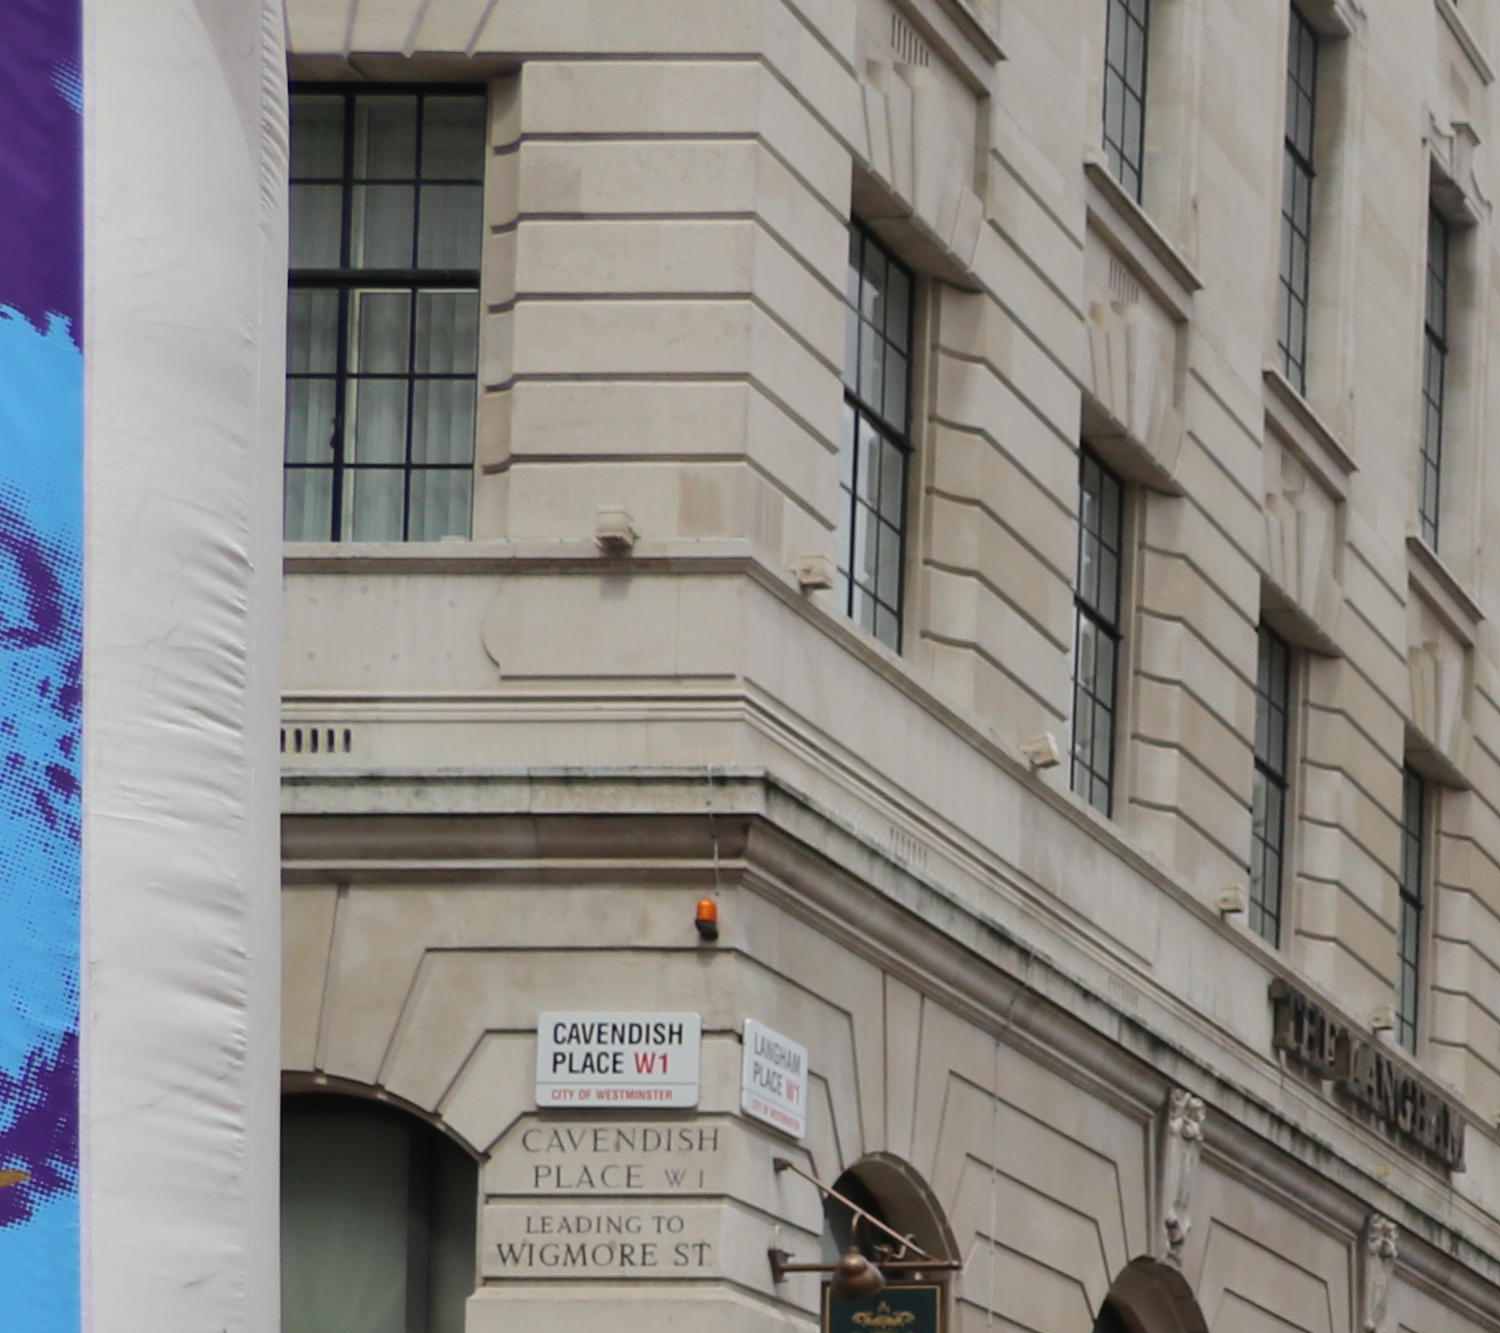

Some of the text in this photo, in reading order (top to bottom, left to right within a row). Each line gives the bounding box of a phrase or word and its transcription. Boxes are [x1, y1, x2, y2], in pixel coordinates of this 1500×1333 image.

[553, 1022, 684, 1045] CAVENDISH
[552, 1052, 669, 1074] PLACE W1
[754, 1032, 801, 1076] LANGHAM
[551, 1089, 673, 1100] CITY OF WESTMINSTER
[753, 1061, 800, 1105] PLACE W1
[521, 1127, 720, 1153] CAVENDISH
[533, 1164, 644, 1189] PLACE
[525, 1215, 685, 1234] LEADING TO
[496, 1242, 658, 1268] WIGMORE
